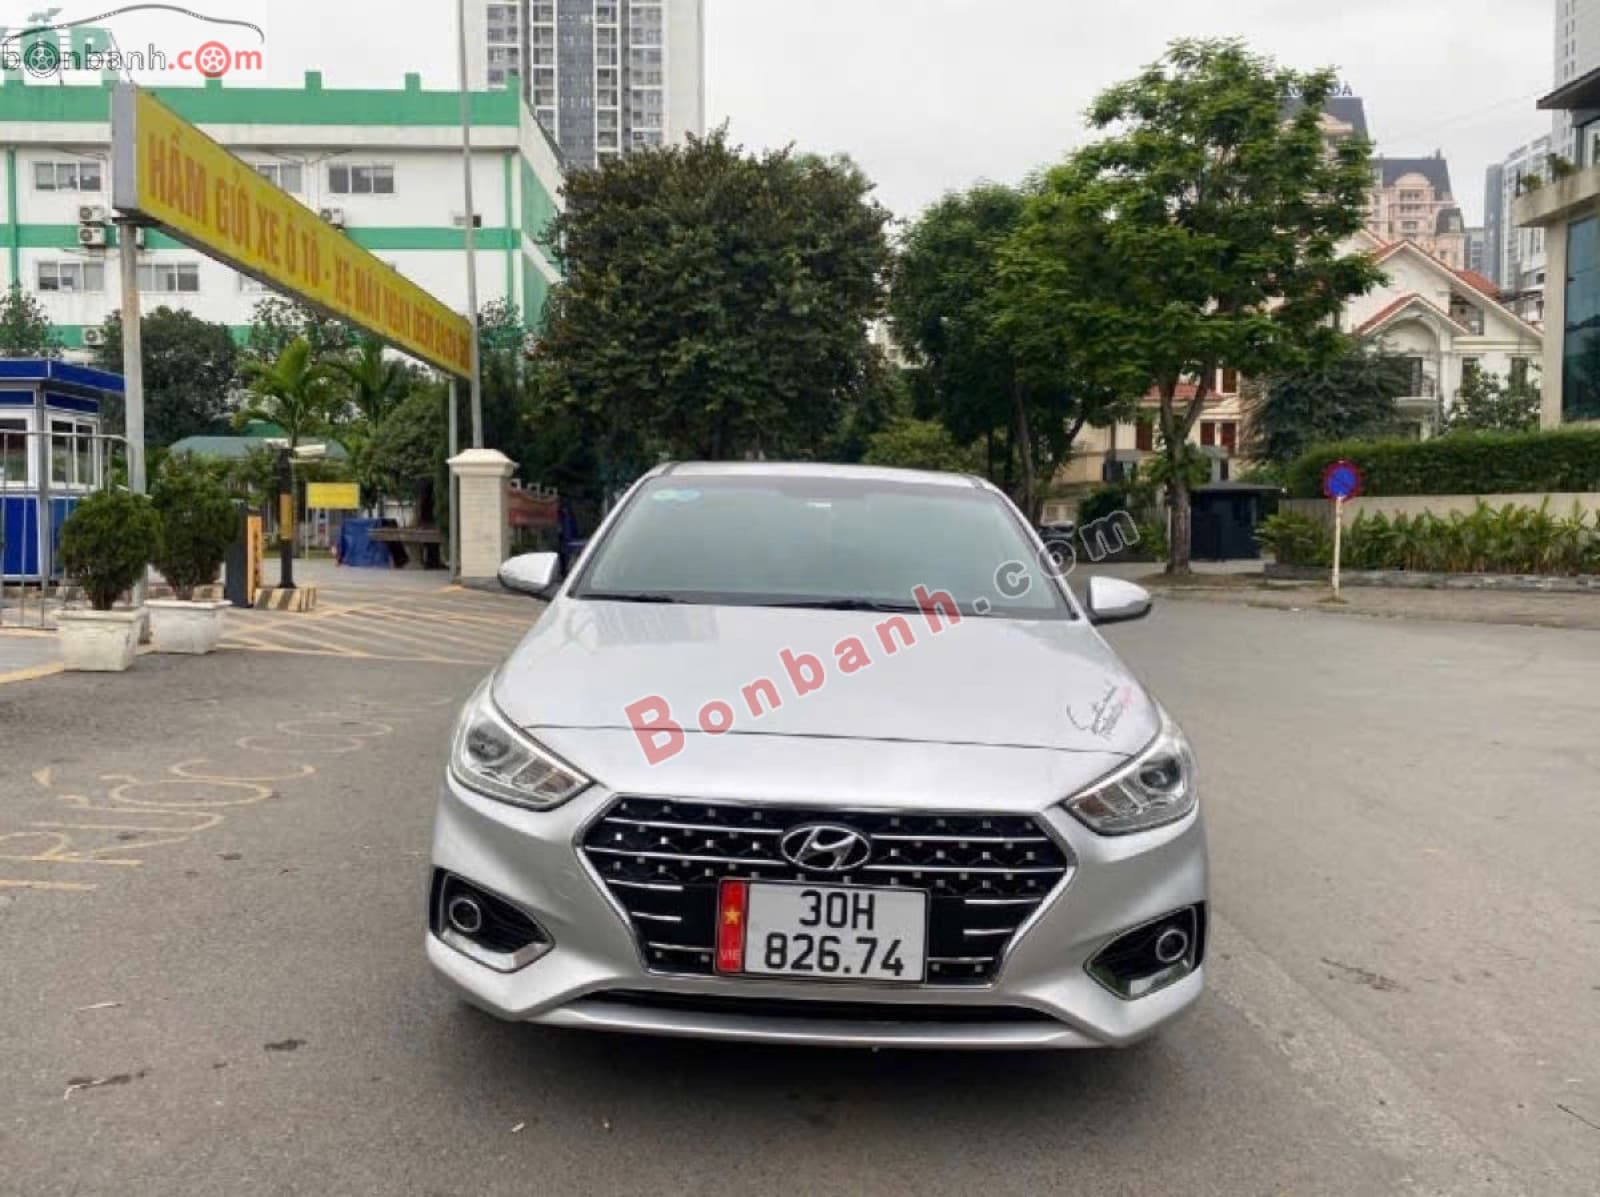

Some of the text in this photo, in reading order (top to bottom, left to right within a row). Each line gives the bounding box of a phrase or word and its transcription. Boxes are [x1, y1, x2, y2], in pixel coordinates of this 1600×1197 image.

[256, 205, 281, 266] XE
[799, 889, 875, 930] 30H
[764, 931, 904, 977] 826.74
